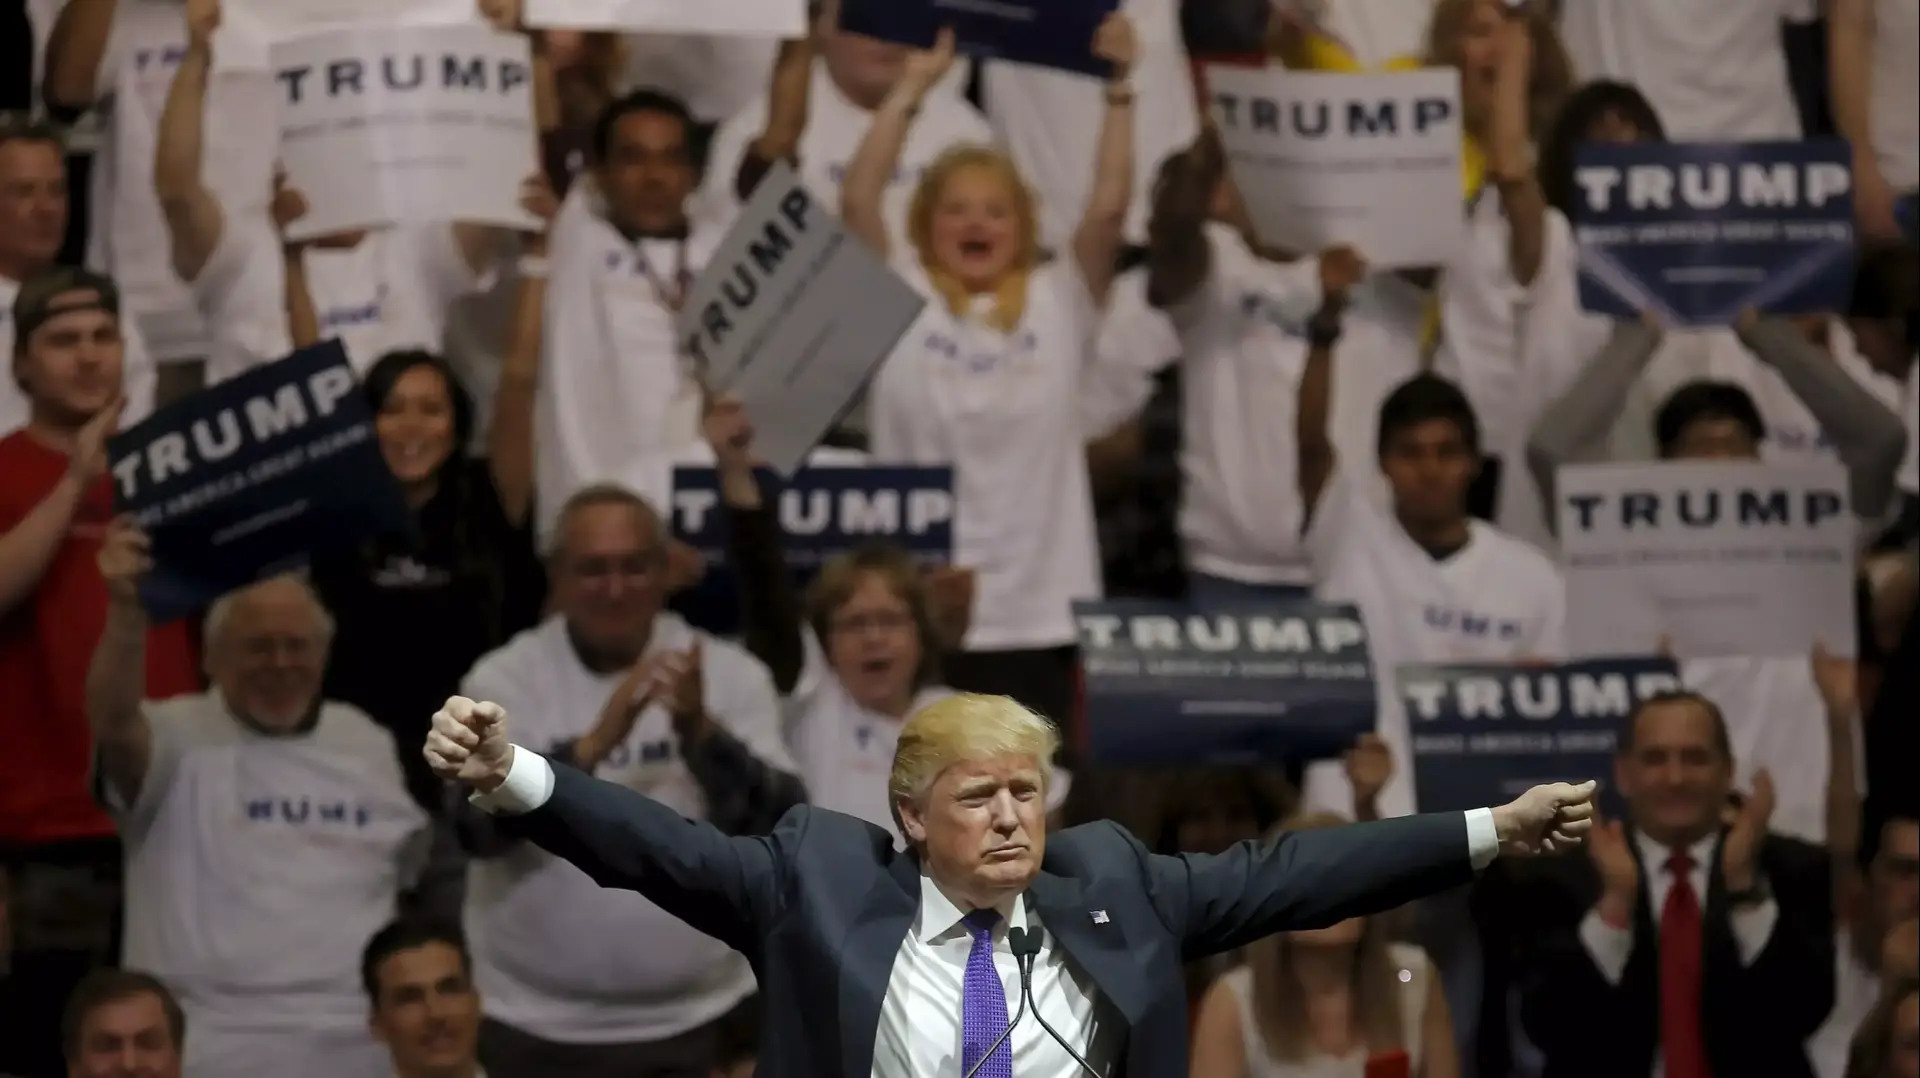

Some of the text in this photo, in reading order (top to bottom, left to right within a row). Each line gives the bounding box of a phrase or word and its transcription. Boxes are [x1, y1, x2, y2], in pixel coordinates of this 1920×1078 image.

[276, 54, 532, 104] TRUMP
[1216, 93, 1451, 138] TRUMP
[1574, 162, 1851, 211] TRUMP
[113, 364, 353, 498] TRUMP
[672, 488, 951, 535] TUMP
[1567, 488, 1842, 532] TRUMP
[1078, 614, 1364, 653] TRUMP
